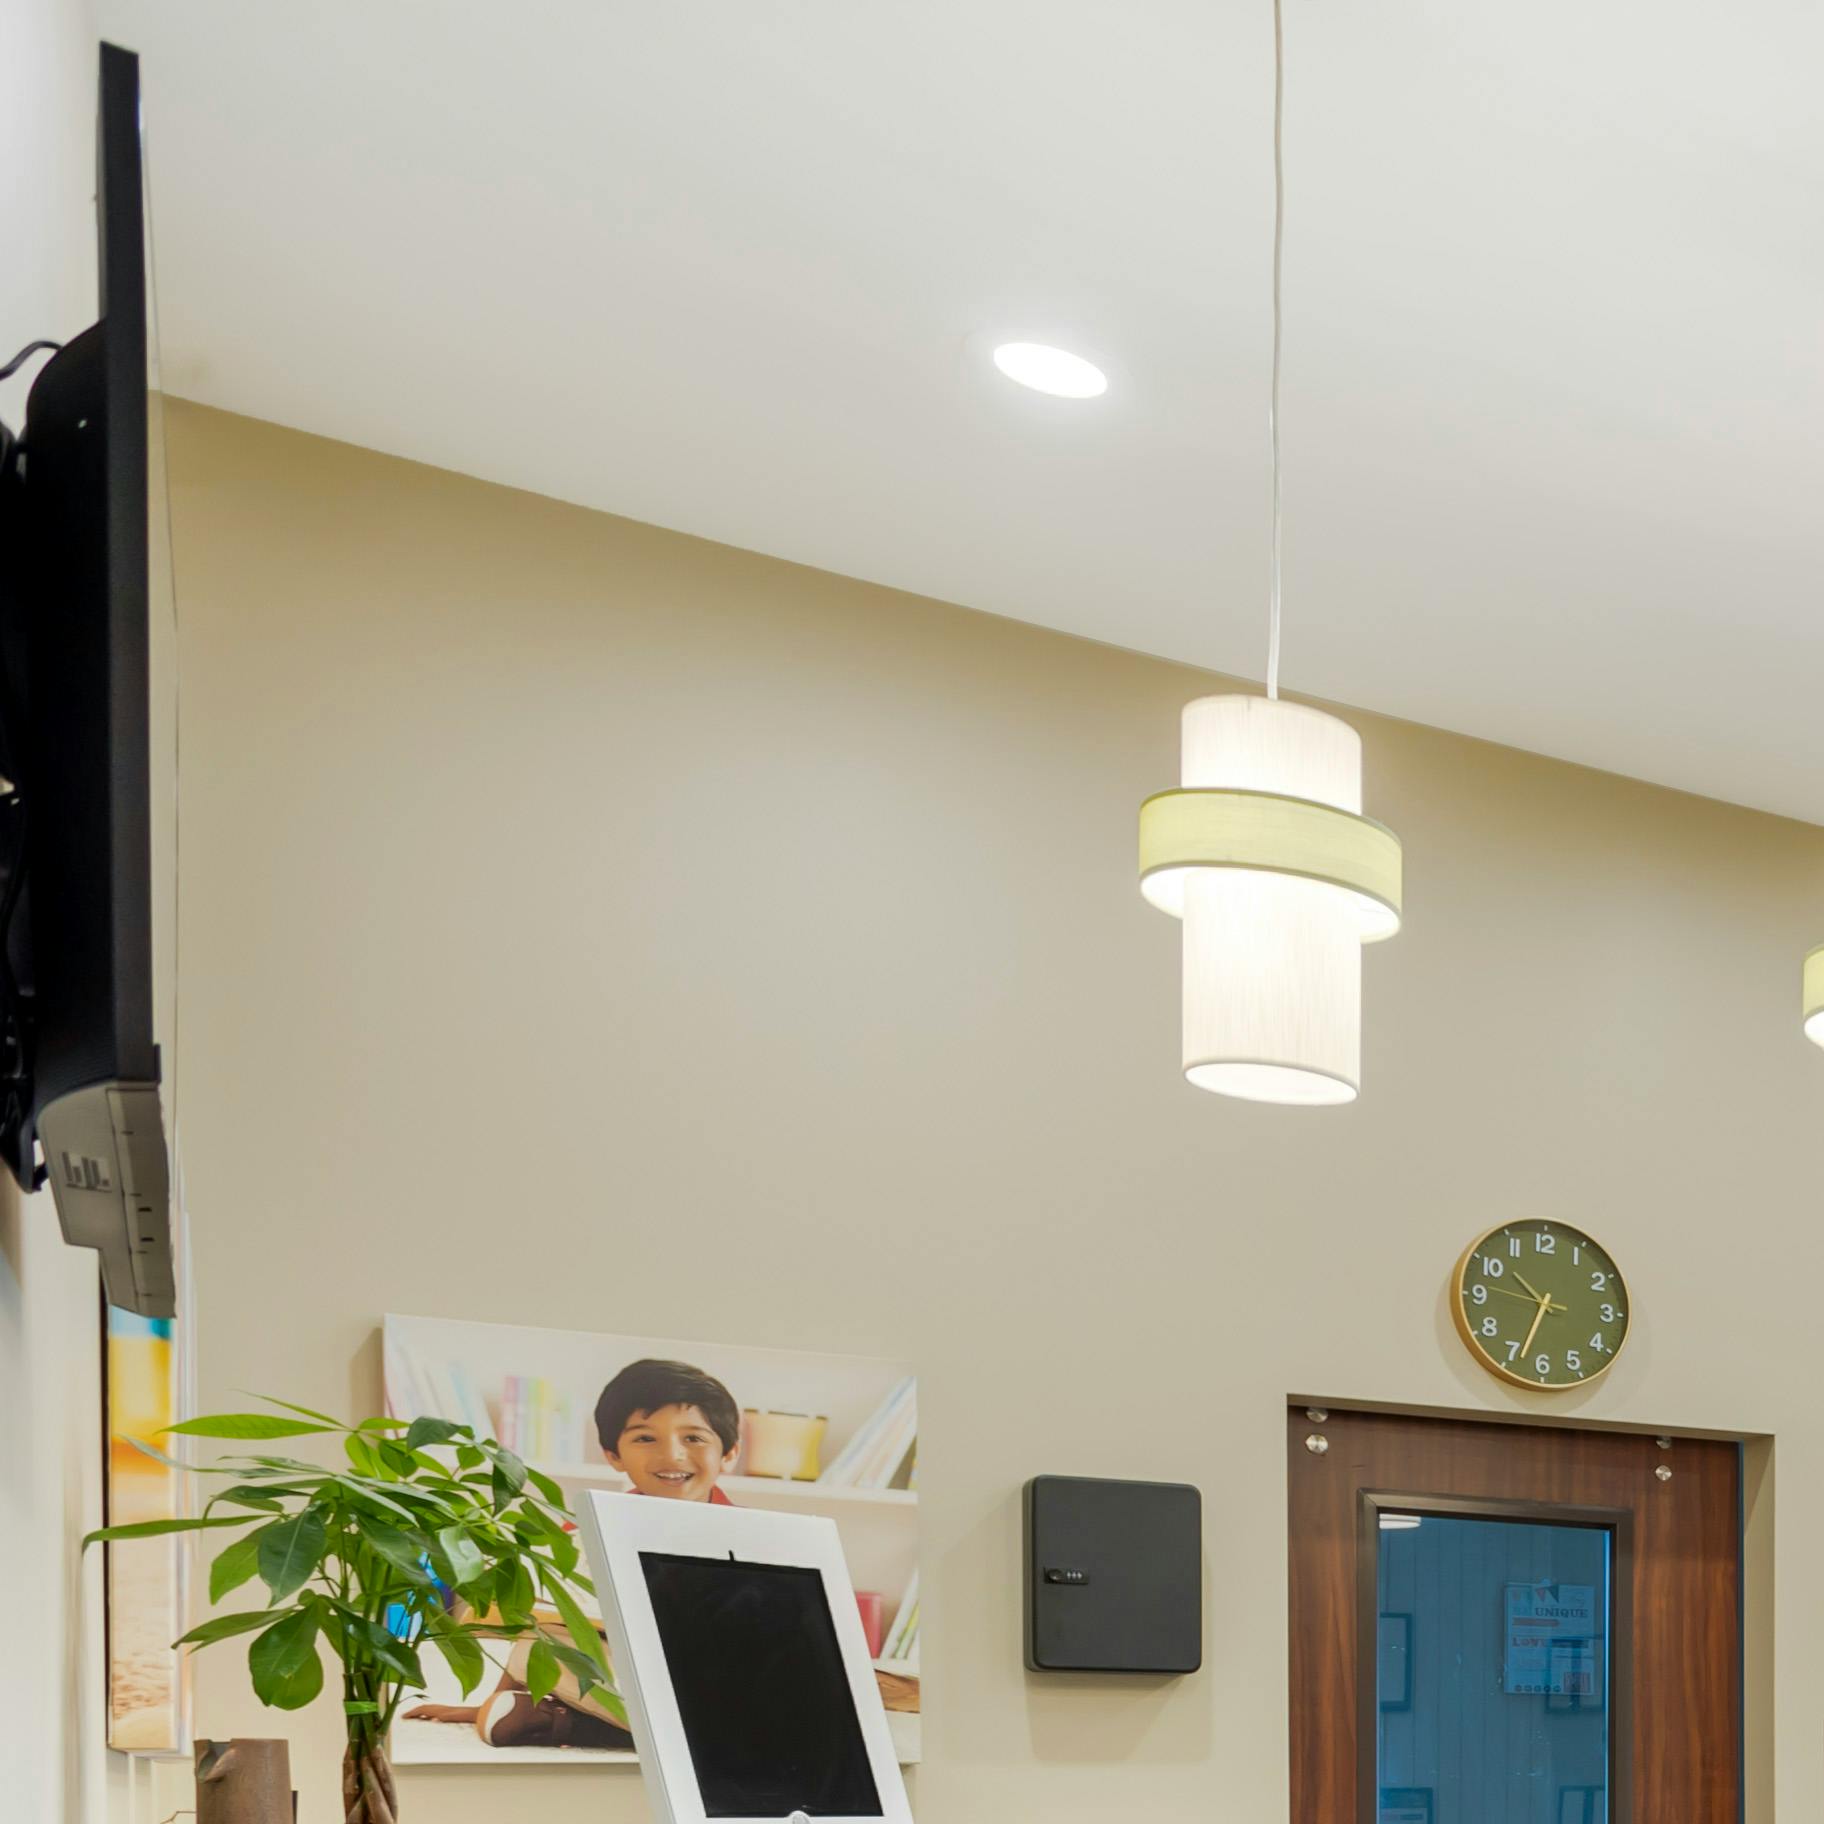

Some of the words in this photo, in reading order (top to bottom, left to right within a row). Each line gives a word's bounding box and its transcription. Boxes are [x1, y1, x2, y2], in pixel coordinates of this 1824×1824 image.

[1509, 1238, 1521, 1258] 11
[1535, 1233, 1556, 1255] 12
[1573, 1247, 1580, 1266] 1
[1483, 1256, 1504, 1278] 10
[1591, 1271, 1606, 1292] 2
[1472, 1284, 1487, 1305] 9
[1600, 1304, 1614, 1323] 3
[1482, 1317, 1498, 1337] 8
[1505, 1341, 1521, 1361] 7
[1589, 1332, 1604, 1352] 4
[1535, 1354, 1550, 1374] 6
[1566, 1350, 1581, 1370] 5
[1535, 1607, 1588, 1618] UNIQUE
